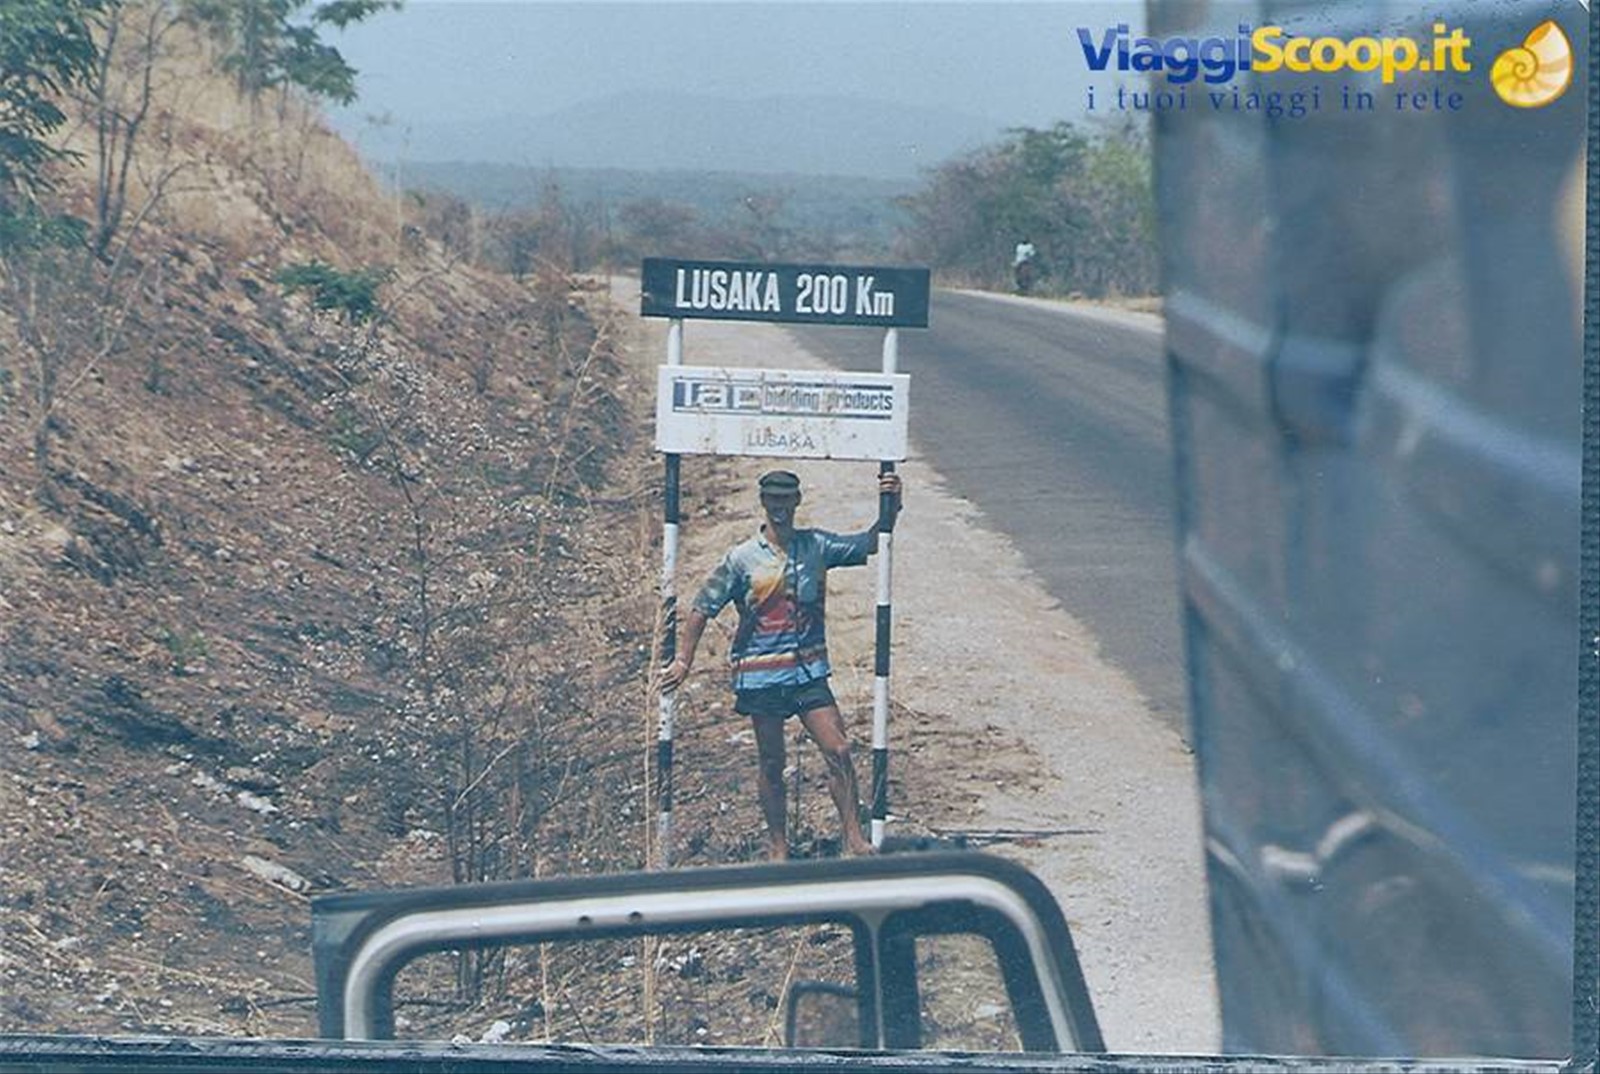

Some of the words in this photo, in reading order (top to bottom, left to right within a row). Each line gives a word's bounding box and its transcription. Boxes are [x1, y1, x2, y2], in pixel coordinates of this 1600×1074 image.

[675, 269, 781, 312] LUSAKA
[796, 274, 847, 314] 200
[855, 276, 894, 316] Km
[747, 427, 815, 449] LUSAKA
